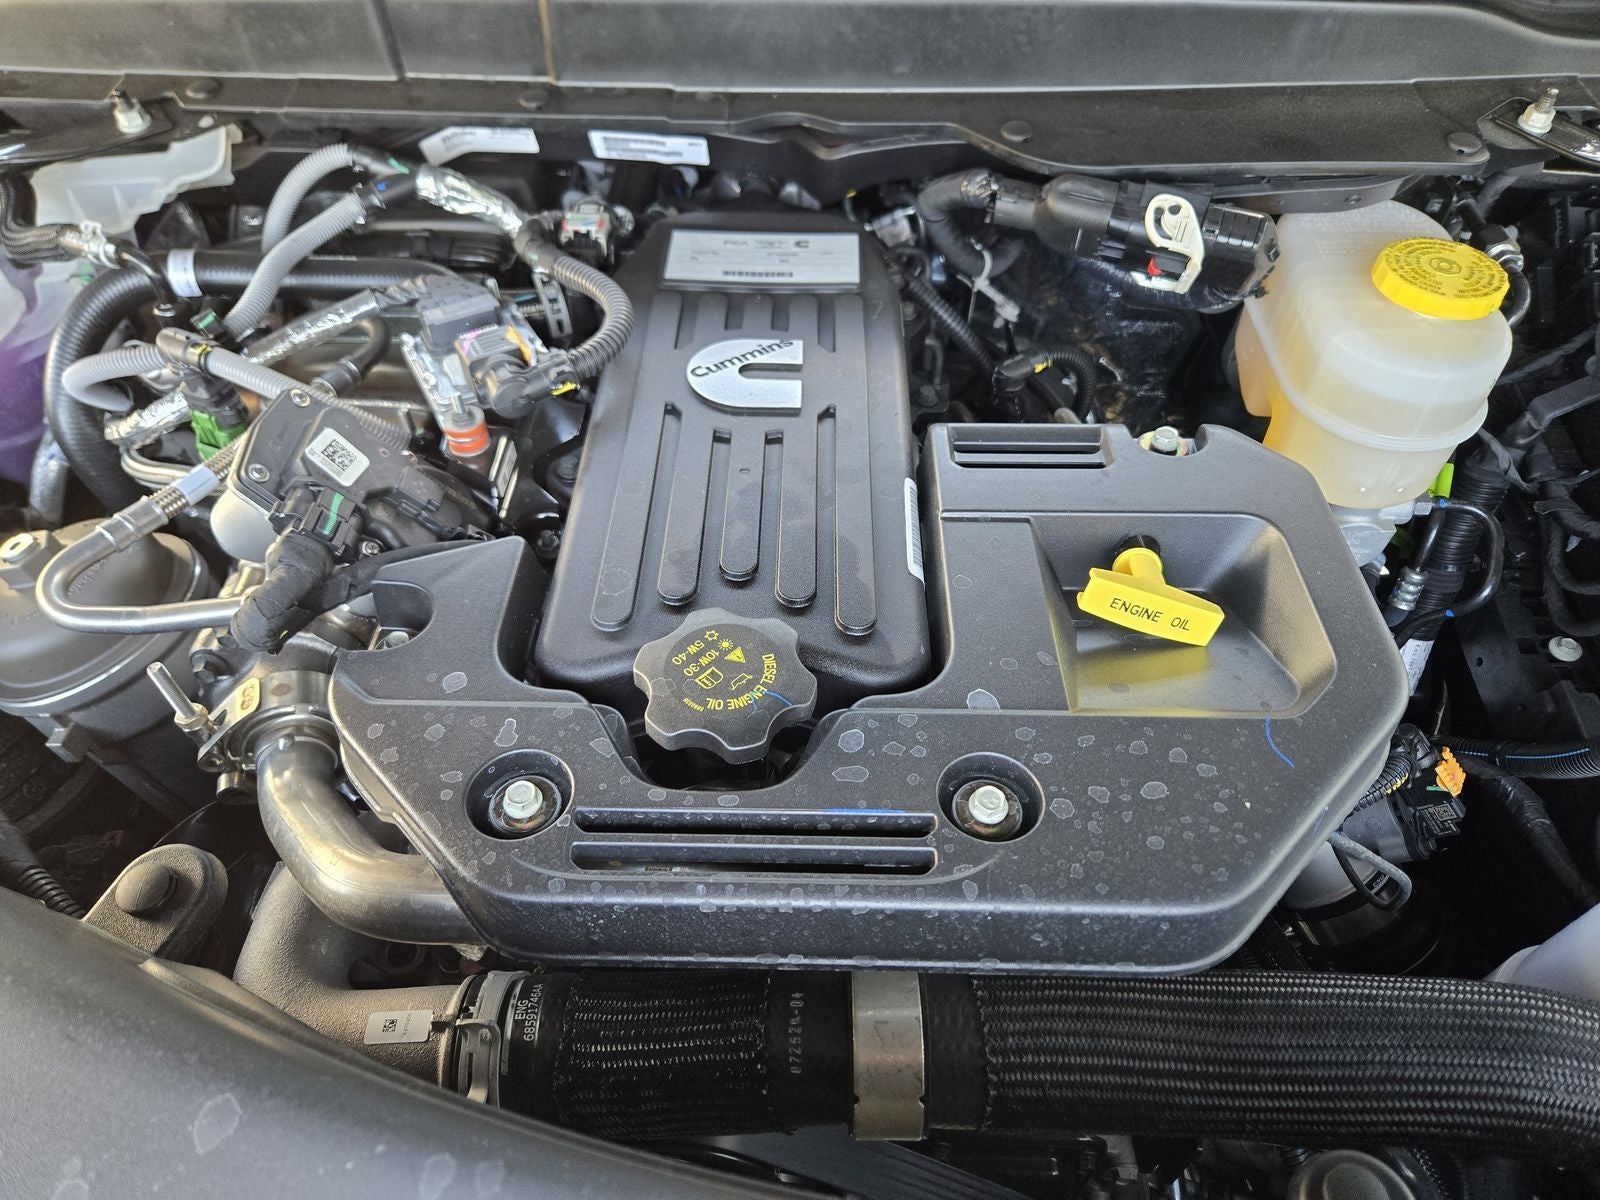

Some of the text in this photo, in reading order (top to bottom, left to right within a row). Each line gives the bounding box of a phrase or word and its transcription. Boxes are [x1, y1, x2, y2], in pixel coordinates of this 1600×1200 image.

[690, 340, 794, 377] Cummins
[1109, 597, 1191, 632] ENGINE OIL
[672, 640, 705, 665] 5W-40
[683, 649, 720, 676] 10W-30
[760, 653, 777, 684] DIESEL
[706, 697, 724, 711] OIL
[726, 684, 767, 710] ENGINE
[514, 999, 529, 1020] ENG
[523, 983, 544, 1042] 68591746AA
